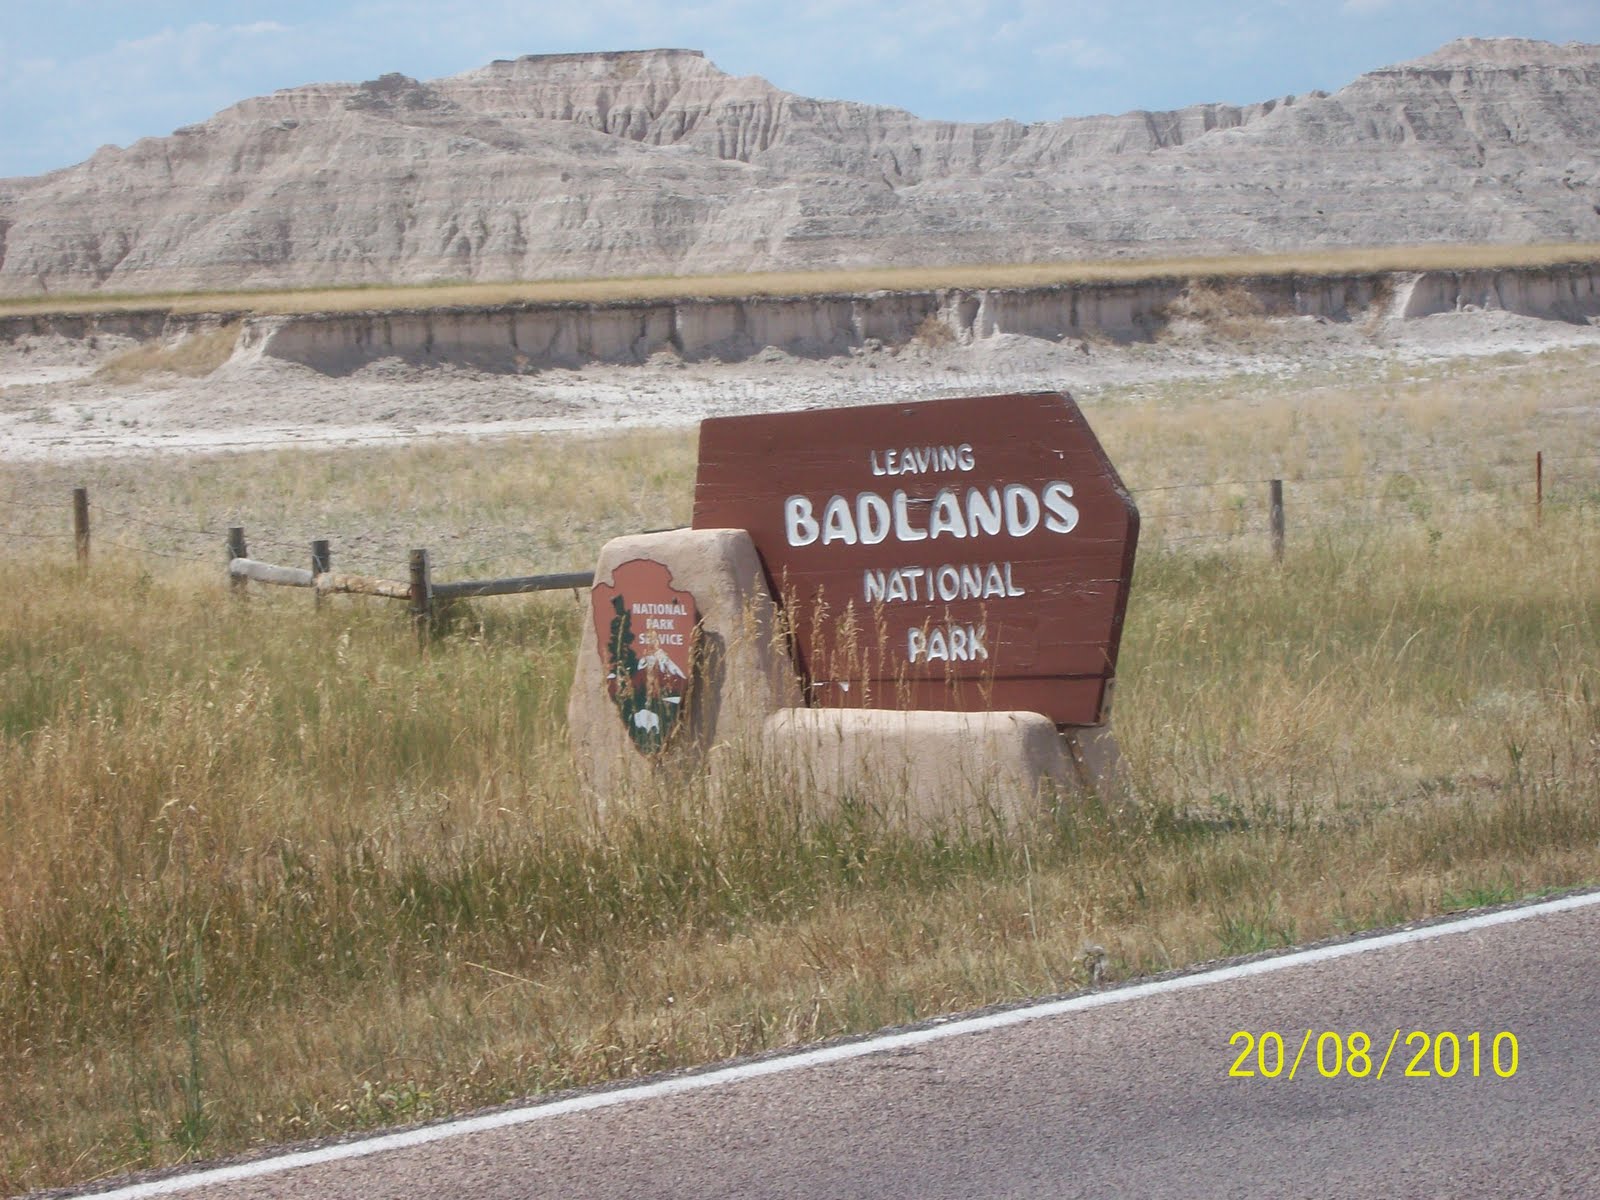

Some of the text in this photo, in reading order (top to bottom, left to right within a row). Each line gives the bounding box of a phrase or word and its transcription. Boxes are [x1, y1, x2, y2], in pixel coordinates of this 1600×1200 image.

[871, 443, 976, 476] LEAVING
[784, 481, 1079, 547] BADLANDS
[863, 561, 1025, 603] NATIONAL
[632, 603, 688, 616] NATIONAL
[646, 618, 675, 630] PARK
[639, 633, 684, 646] SEVICE
[908, 625, 988, 663] PARK
